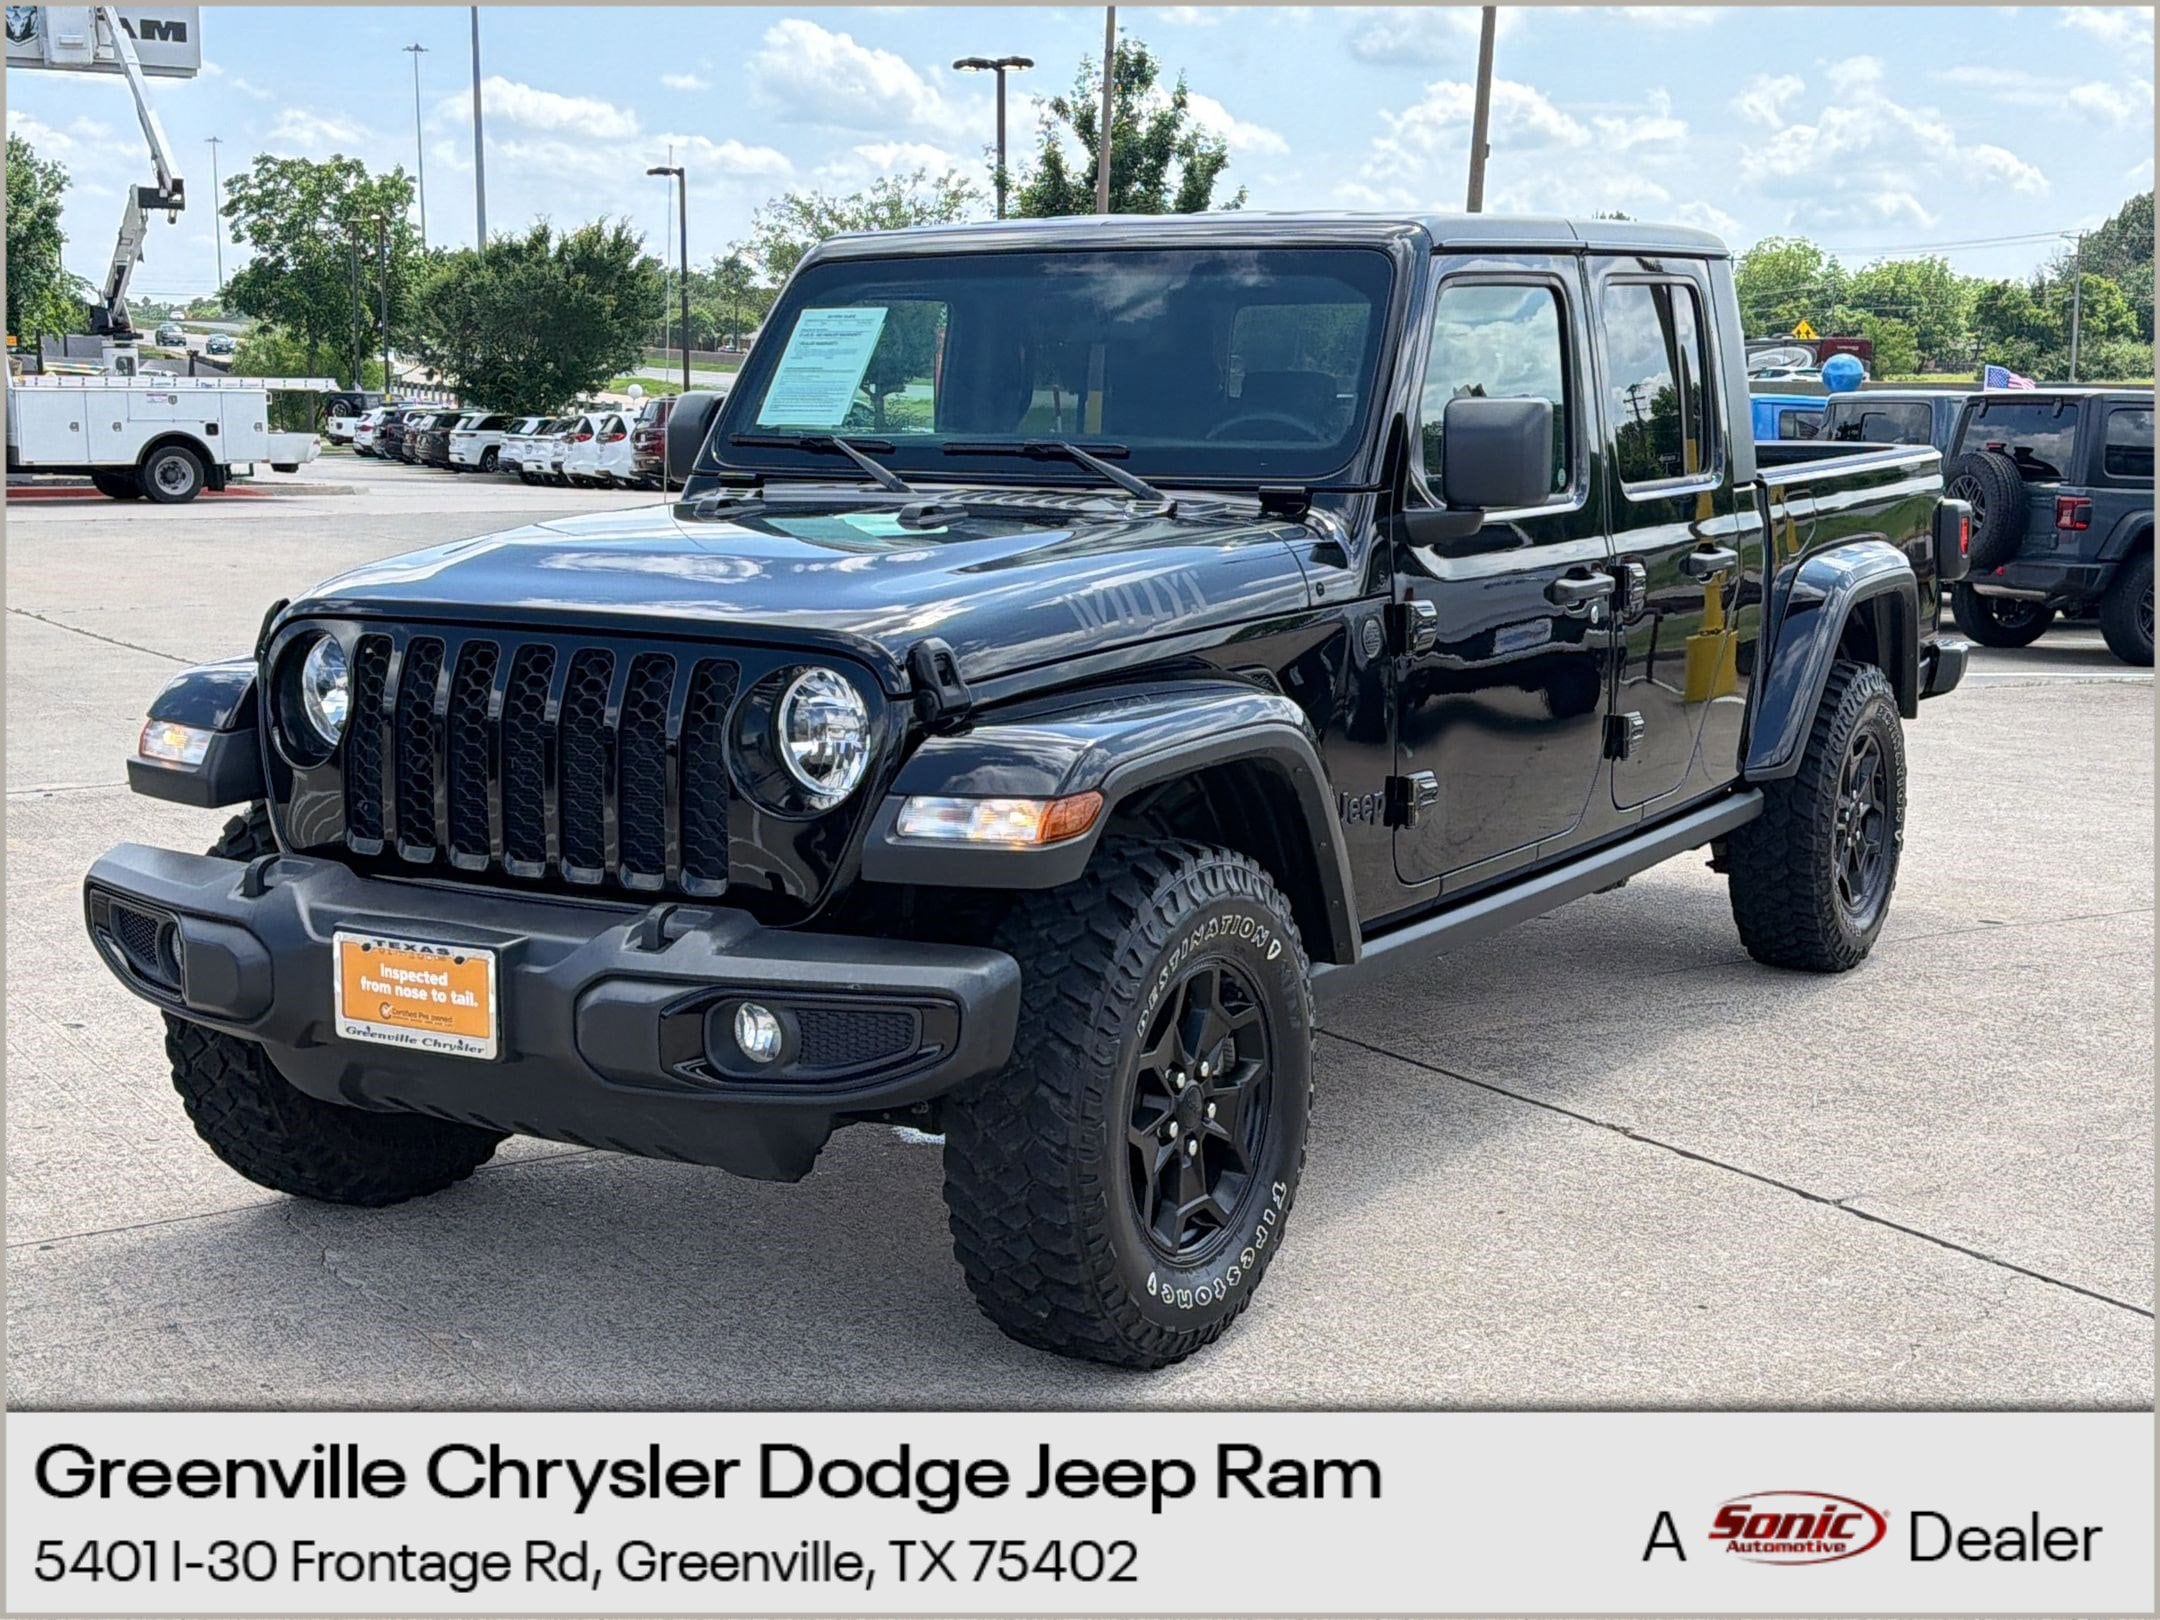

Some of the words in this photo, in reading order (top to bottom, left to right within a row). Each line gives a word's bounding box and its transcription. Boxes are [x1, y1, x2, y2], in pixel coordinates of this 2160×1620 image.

[1339, 791, 1386, 826] Jeep
[373, 939, 450, 956] TEXAS
[360, 975, 392, 995] from
[395, 985, 428, 1001] nose
[431, 988, 448, 1004] to
[450, 990, 478, 1008] tail.
[381, 963, 448, 987] Inspected
[1136, 914, 1270, 1038] DESTINATION
[345, 1026, 418, 1044] Greenville
[421, 1038, 486, 1055] Chrysler
[1159, 1181, 1287, 1310] Firestone
